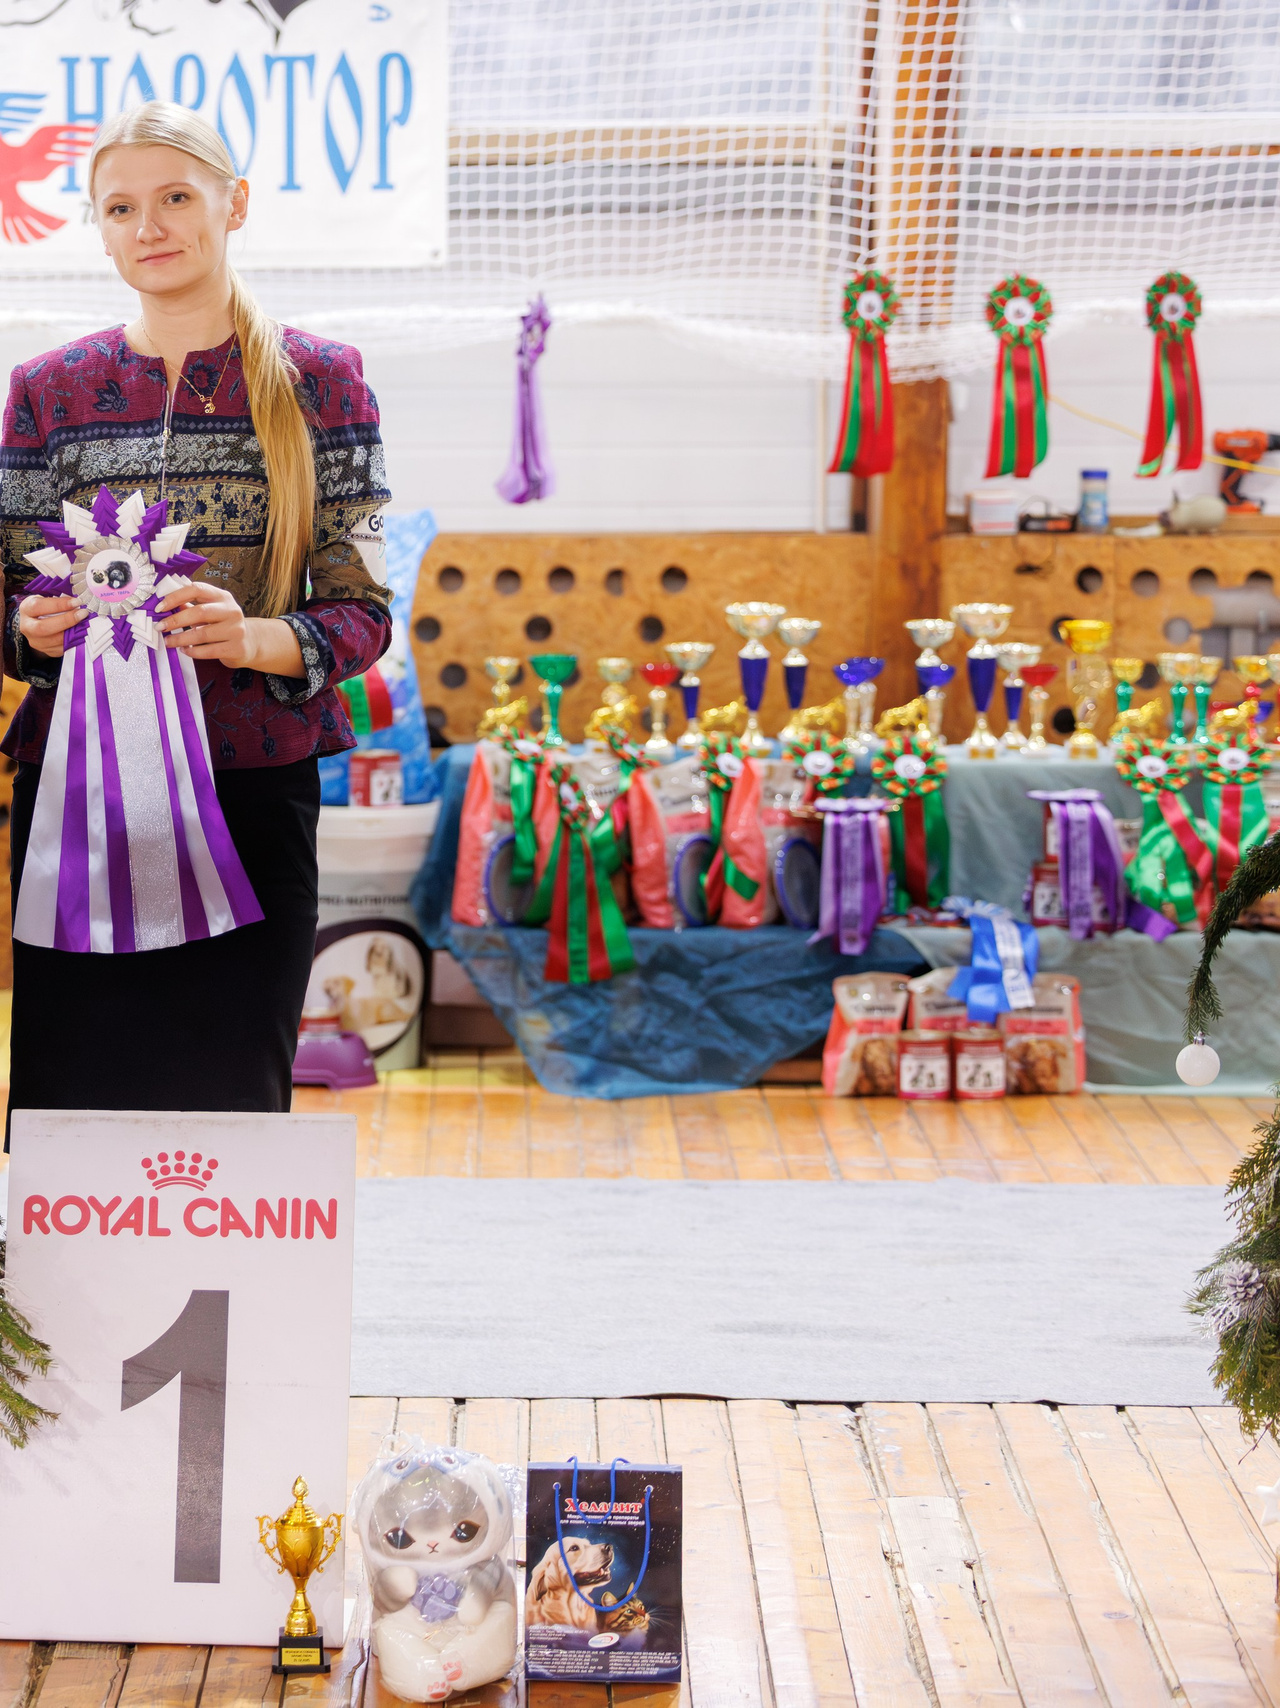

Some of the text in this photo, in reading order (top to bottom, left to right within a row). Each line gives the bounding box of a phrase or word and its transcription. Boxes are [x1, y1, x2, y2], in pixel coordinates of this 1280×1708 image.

[23, 1194, 337, 1240] ROYAL CANIN
[120, 1289, 230, 1584] 1
